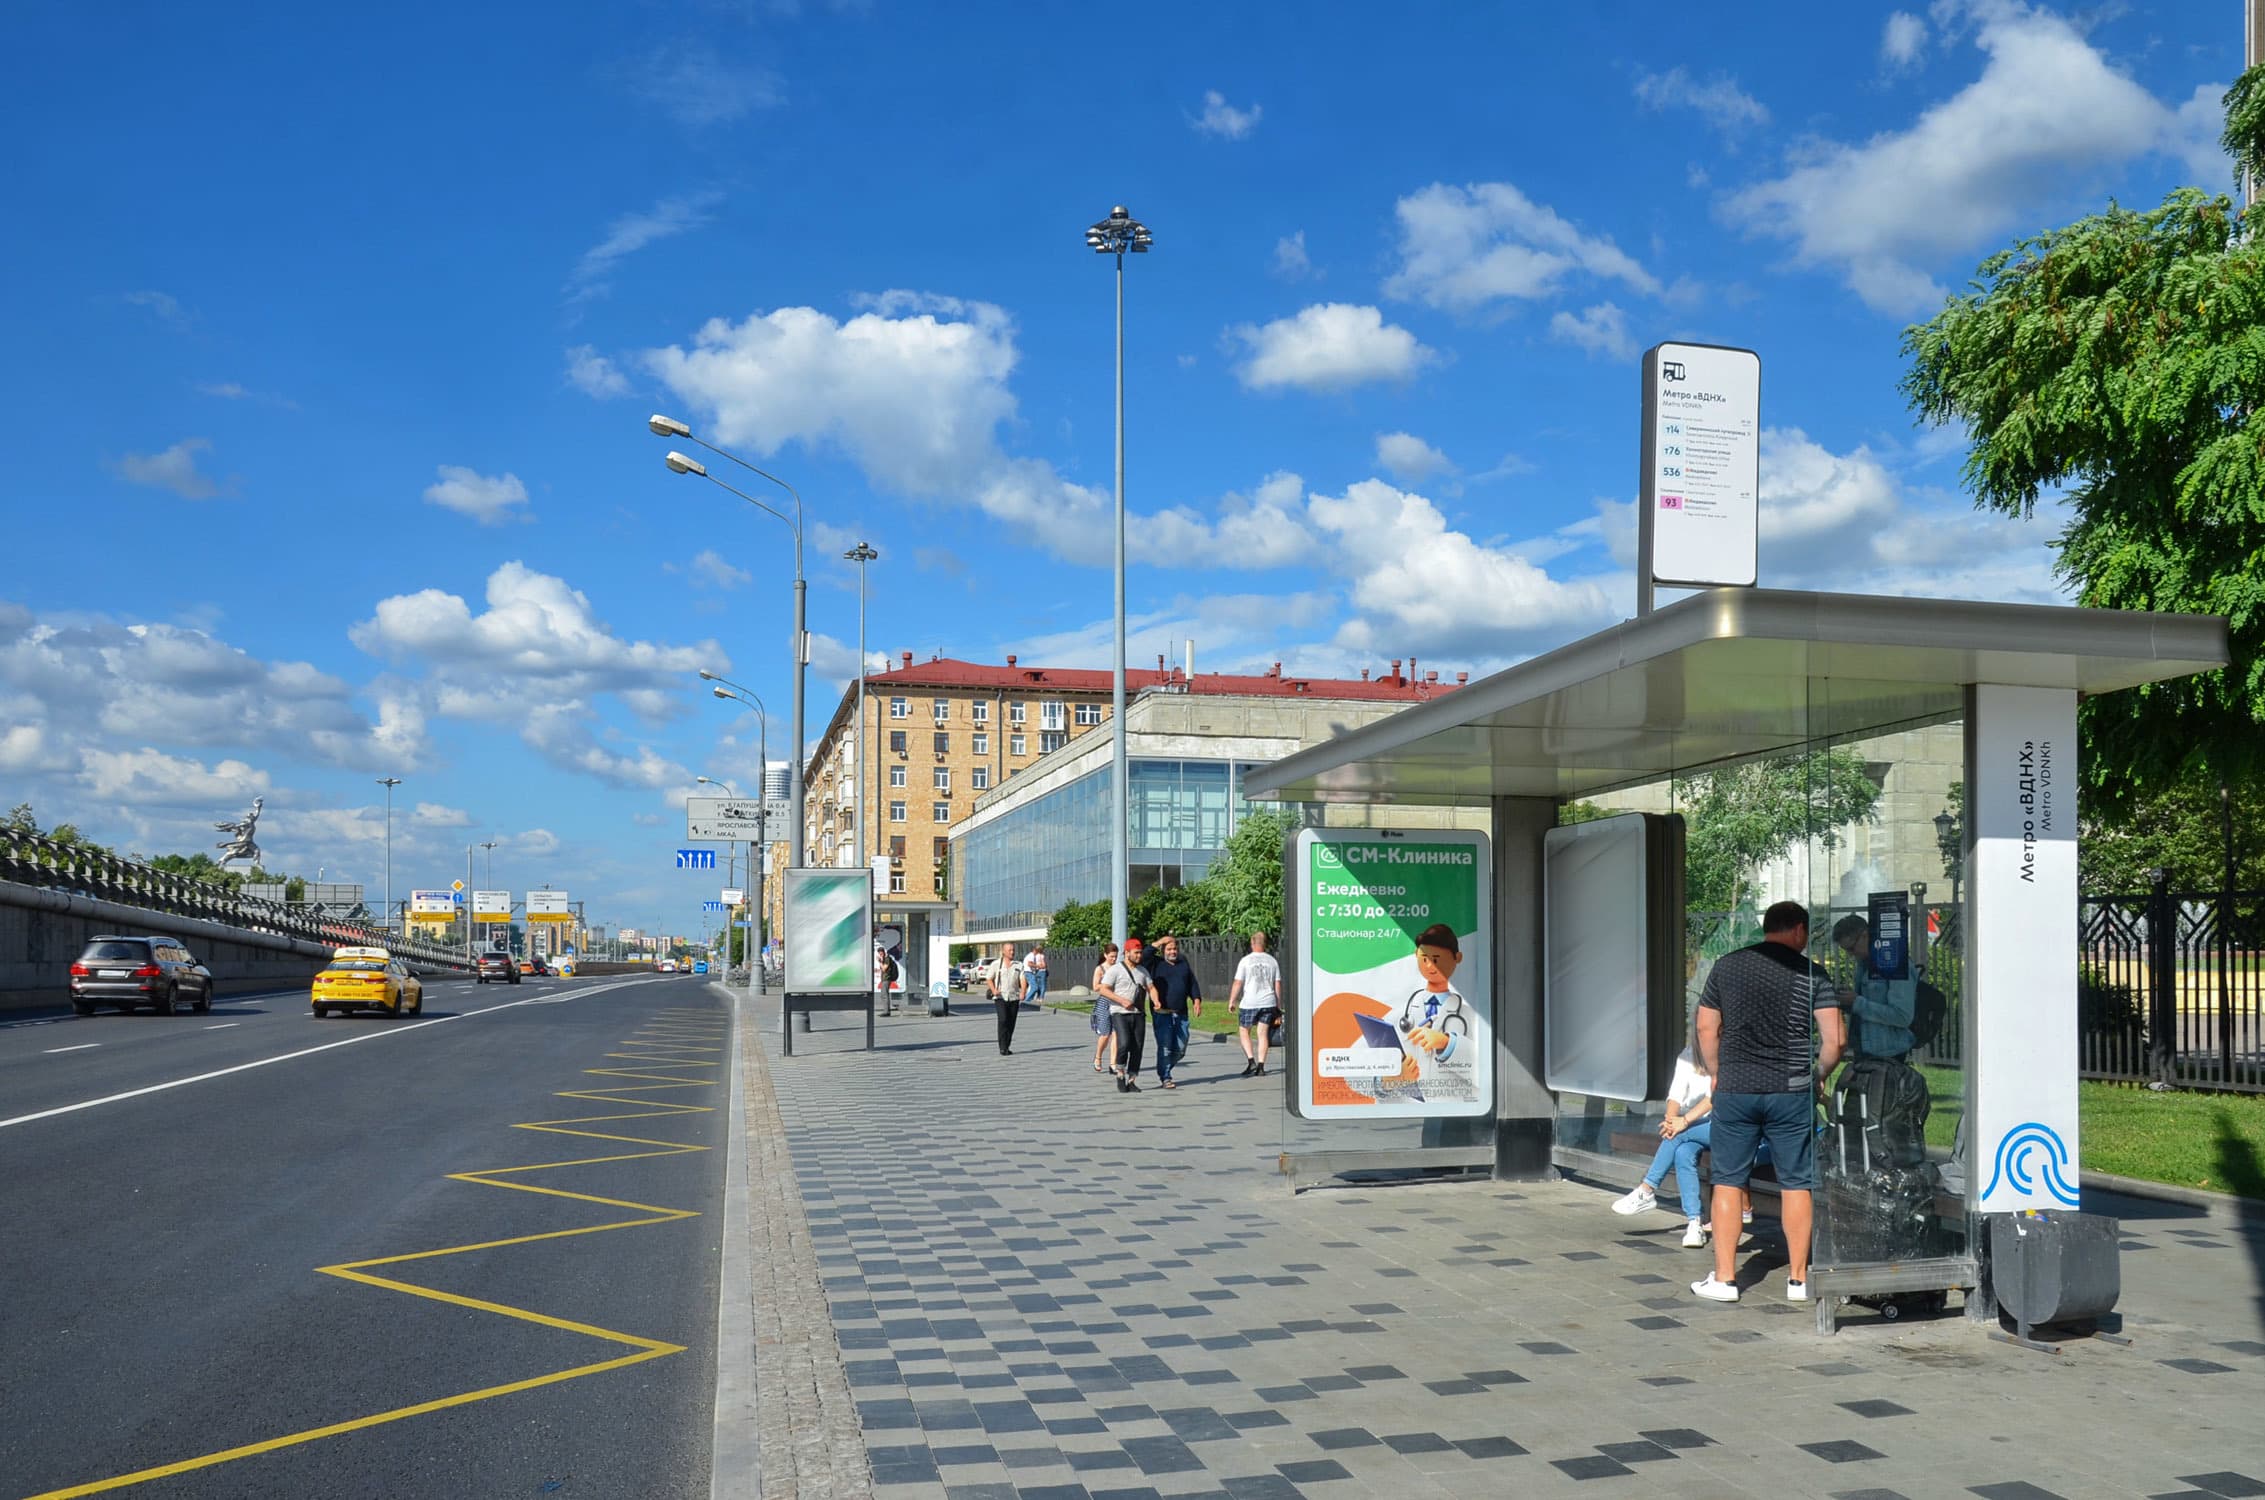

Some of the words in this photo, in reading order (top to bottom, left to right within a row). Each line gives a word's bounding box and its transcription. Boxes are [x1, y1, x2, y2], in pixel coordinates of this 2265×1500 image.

[1662, 389, 1692, 400] Метро
[1693, 392, 1727, 402] «ВДНХ»
[1662, 400, 1680, 408] Metro
[1664, 446, 1681, 456] т76
[1663, 467, 1681, 476] 536
[1665, 498, 1677, 507] 93
[2040, 741, 2050, 788] VDNKh
[2019, 741, 2036, 815] «ВДНХ»
[2041, 791, 2051, 831] Metro
[1346, 848, 1473, 865] СМ-Клиника
[2020, 820, 2037, 883] Метро
[1317, 882, 1406, 896] Ежедневно
[1317, 907, 1325, 917] с
[1329, 904, 1362, 917] 7:30
[1364, 906, 1385, 919] до
[1388, 904, 1430, 917] 22:00
[1316, 928, 1375, 940] Стационар
[1378, 928, 1401, 938] 24/7
